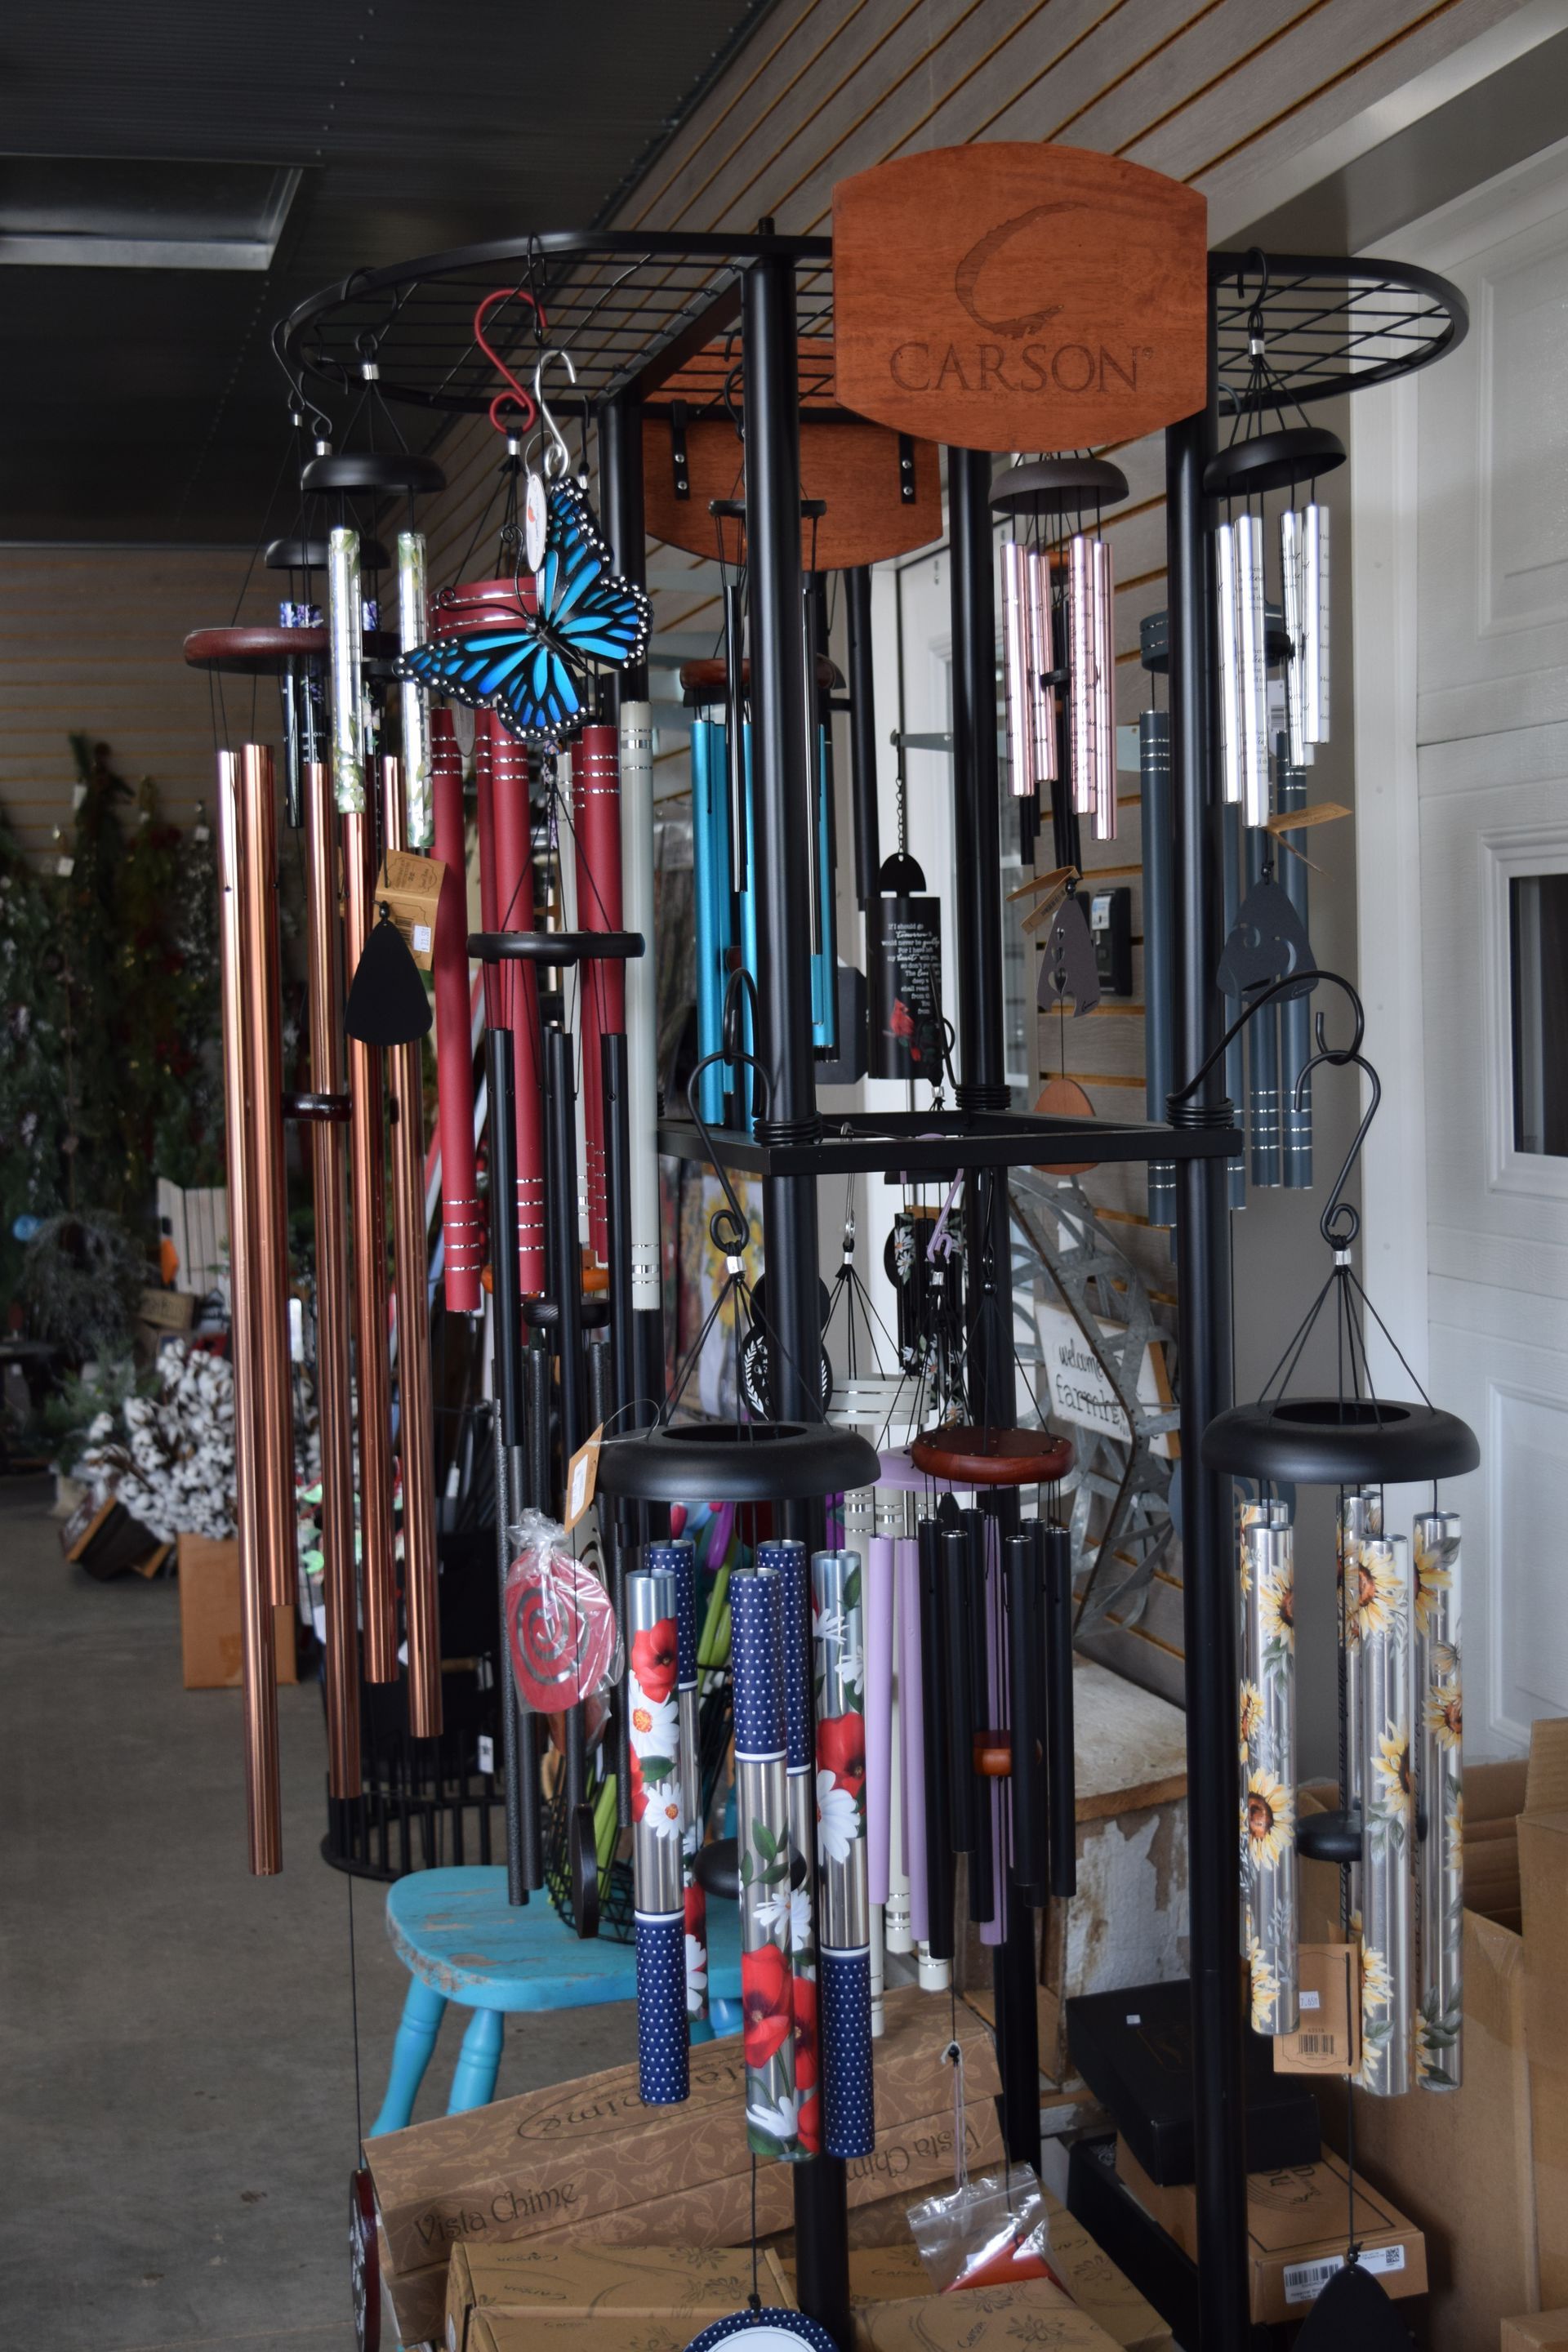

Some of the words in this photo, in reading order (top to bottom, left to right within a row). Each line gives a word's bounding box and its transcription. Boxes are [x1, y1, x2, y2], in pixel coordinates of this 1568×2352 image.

[889, 342, 1138, 393] CARSON
[846, 2145, 910, 2181] Chim
[413, 2212, 488, 2246] Vista
[491, 2183, 578, 2223] Chime
